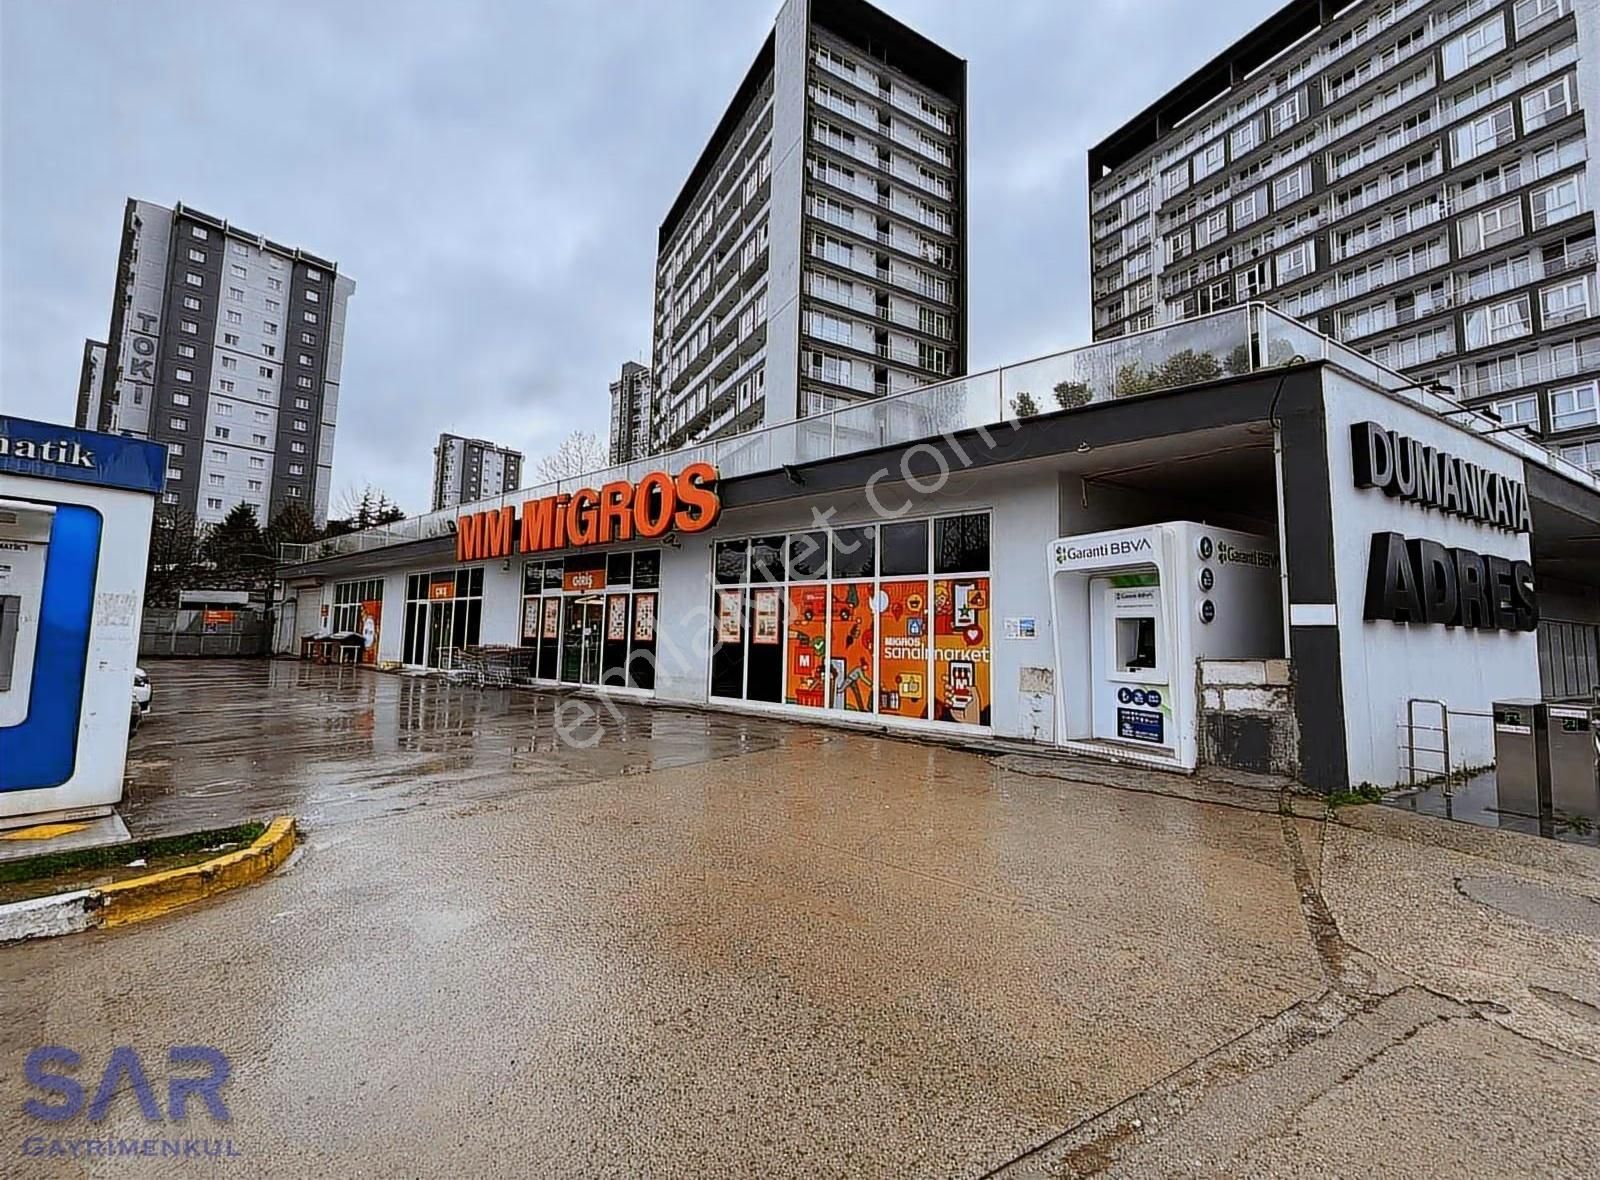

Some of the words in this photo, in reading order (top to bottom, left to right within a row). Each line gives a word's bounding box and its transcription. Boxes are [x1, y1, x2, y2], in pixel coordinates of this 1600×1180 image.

[1350, 421, 1534, 533] DUMANKAYA
[457, 505, 515, 562] MM
[1067, 544, 1108, 560] Garanti
[1110, 538, 1152, 555] BBVA
[1362, 532, 1540, 632] ADRES
[799, 655, 810, 667] M
